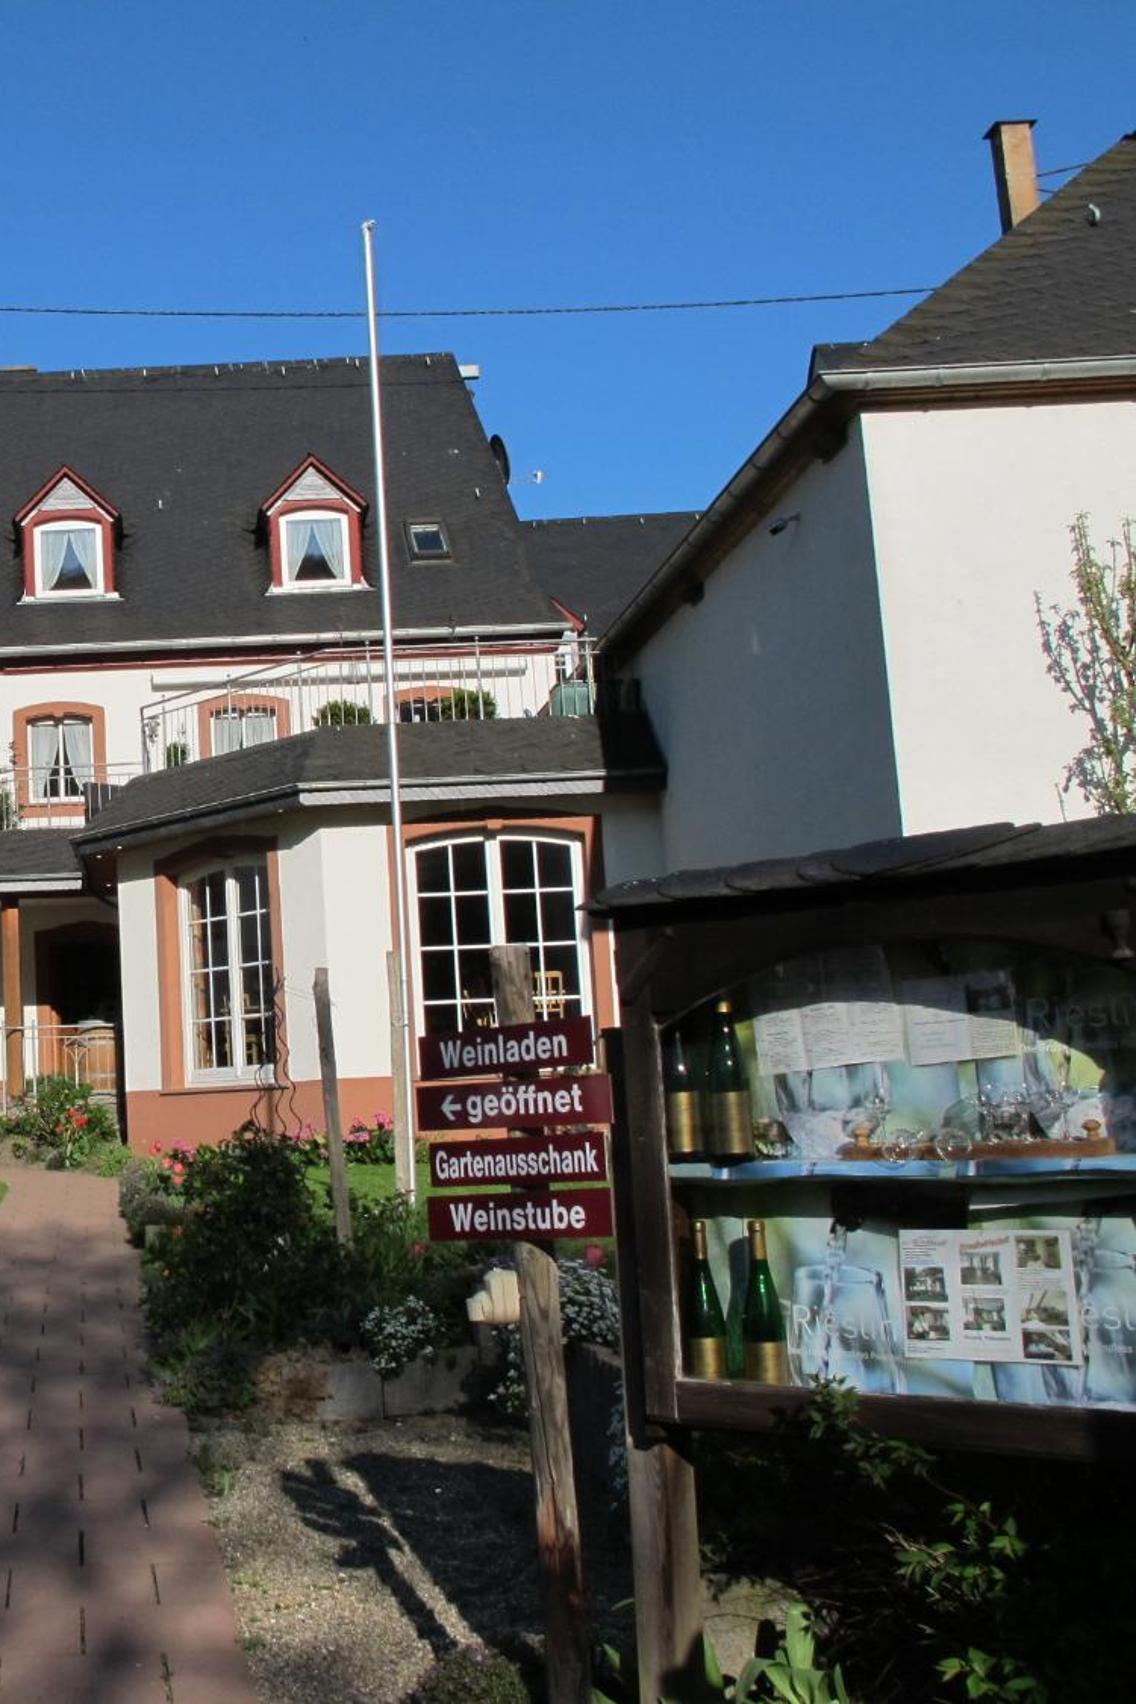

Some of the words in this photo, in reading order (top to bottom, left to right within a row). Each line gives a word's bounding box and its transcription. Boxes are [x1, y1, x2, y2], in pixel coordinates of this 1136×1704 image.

[439, 1031, 568, 1070] Weinladen
[466, 1083, 583, 1123] geöffnet
[435, 1142, 600, 1181] Gartenausschank
[449, 1200, 586, 1233] Weinstube
